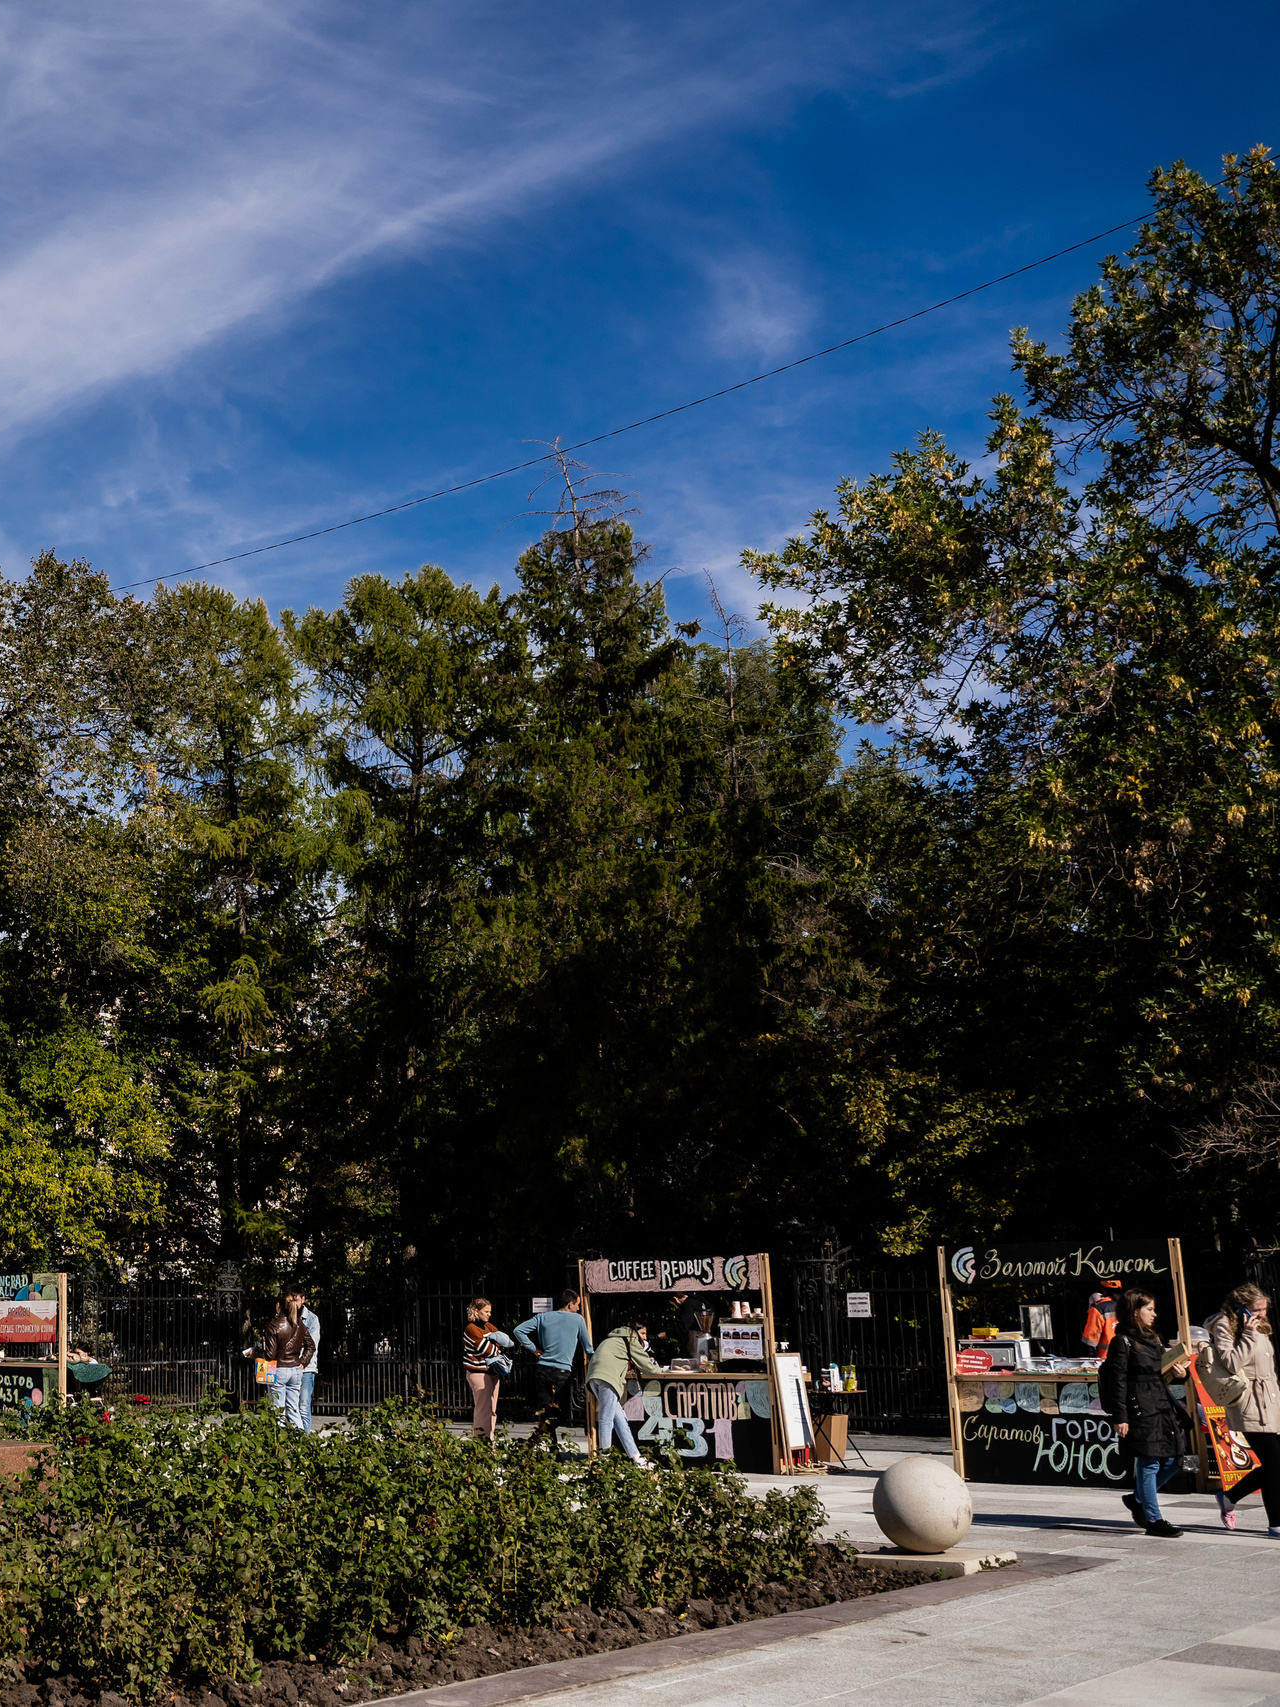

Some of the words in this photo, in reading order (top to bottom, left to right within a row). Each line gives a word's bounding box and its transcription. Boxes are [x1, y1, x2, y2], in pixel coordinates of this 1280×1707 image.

[609, 1260, 655, 1281] COFFEE
[660, 1258, 713, 1289] REDBUS
[980, 1249, 1066, 1279] Золотой
[1070, 1246, 1168, 1278] Колосок
[0, 1387, 19, 1404] 431
[664, 1382, 738, 1421] САРАТОВ
[638, 1416, 734, 1459] 431
